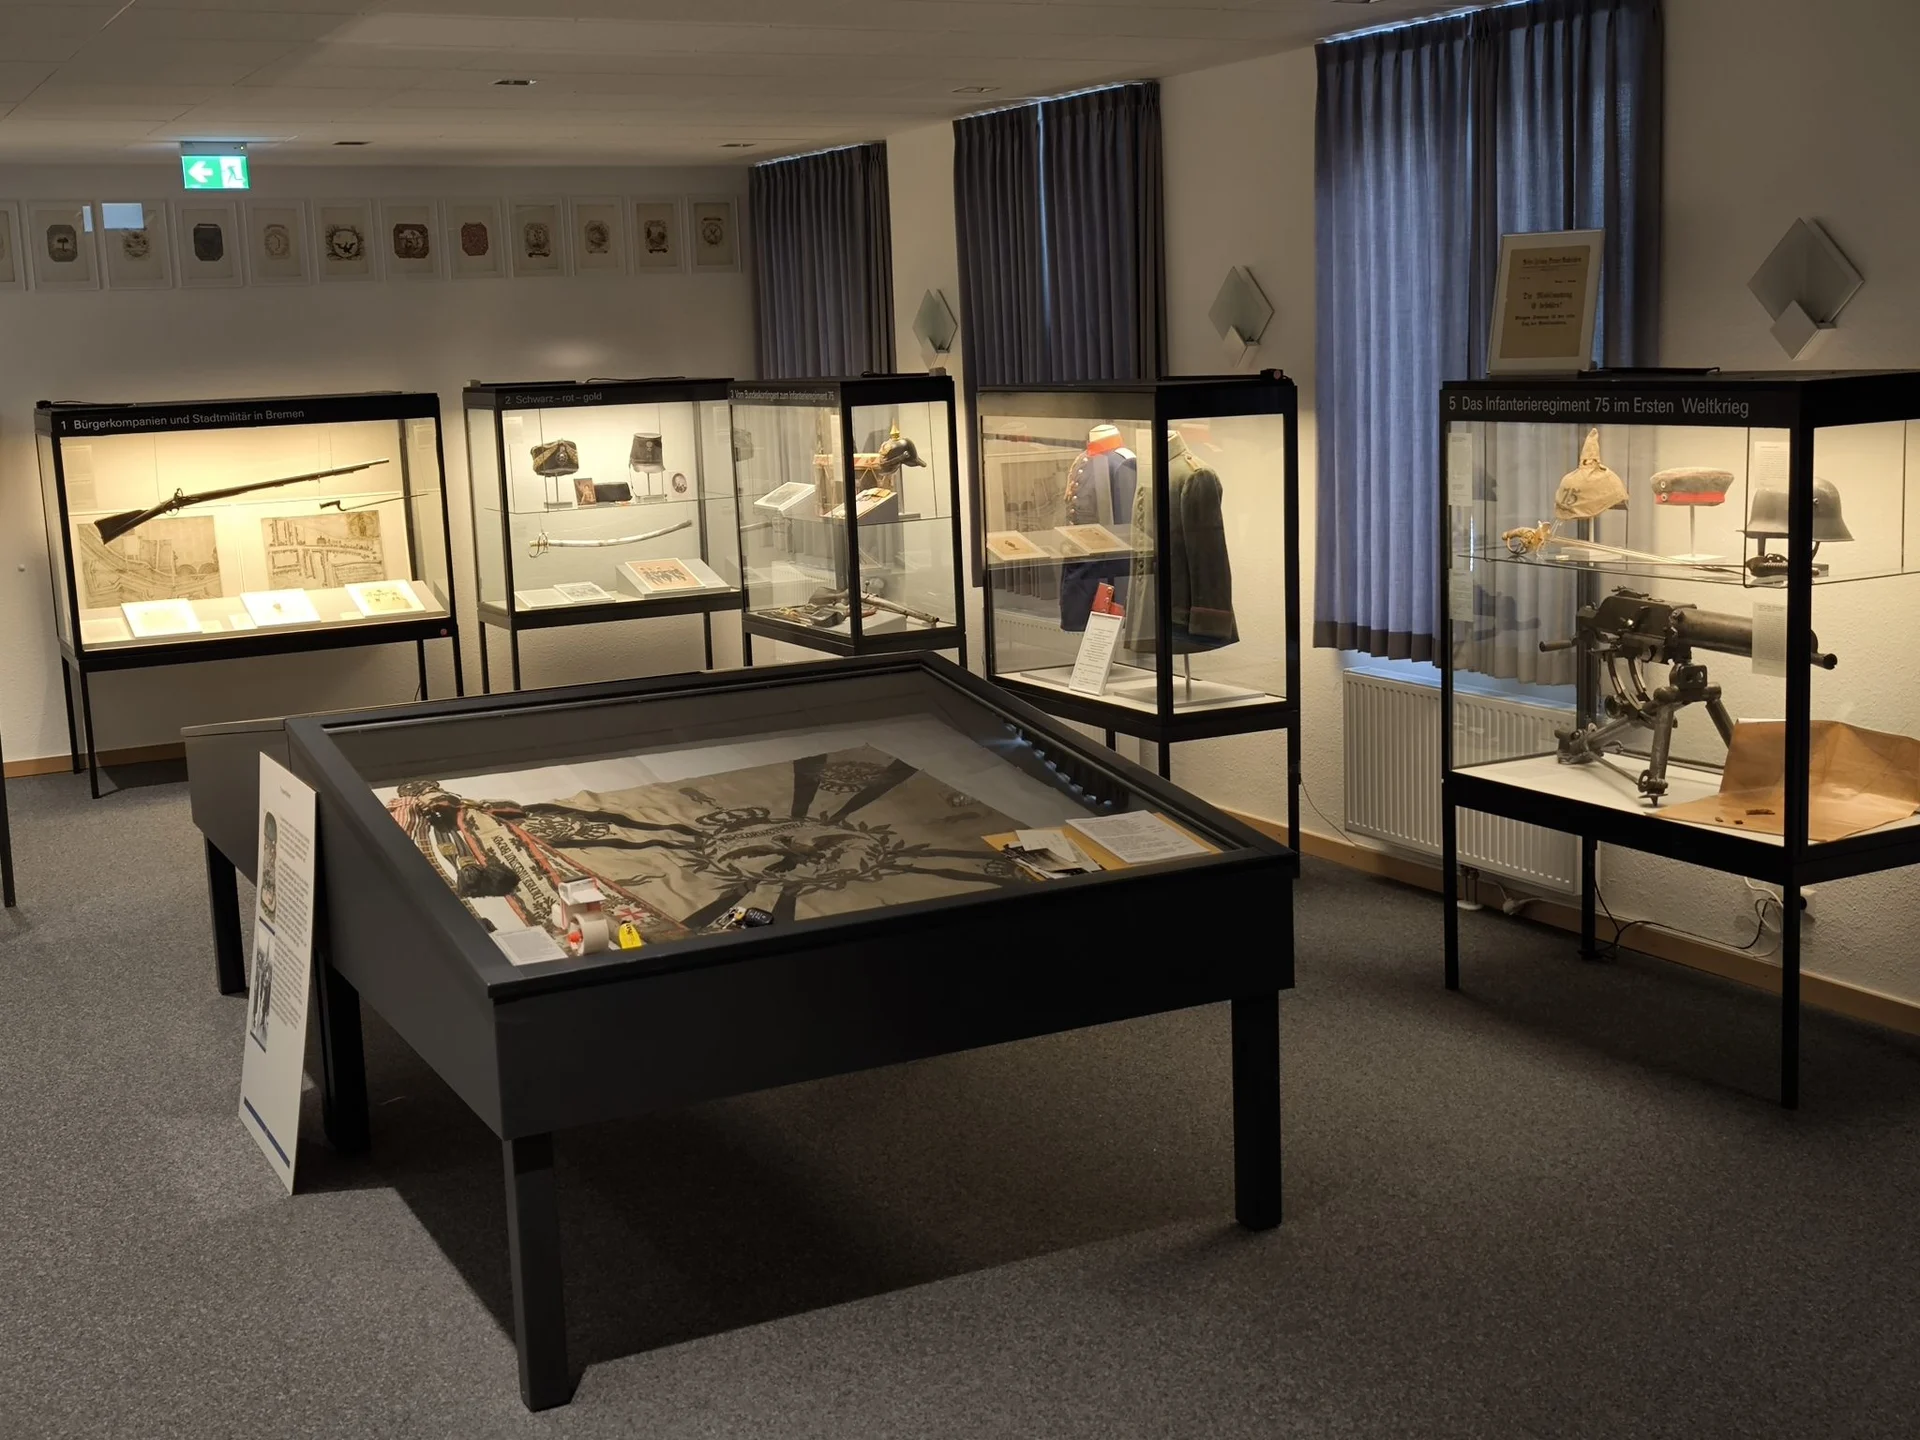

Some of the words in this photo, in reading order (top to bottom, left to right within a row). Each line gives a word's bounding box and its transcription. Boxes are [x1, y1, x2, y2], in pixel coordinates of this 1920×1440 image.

[505, 396, 511, 404] 2
[515, 394, 554, 404] Schwarz
[583, 392, 602, 403] gold
[1449, 396, 1456, 410] 5
[1462, 396, 1482, 410] Das
[1486, 396, 1590, 415] Infanterieregiment
[1594, 397, 1610, 412] 75
[1614, 397, 1629, 412] im
[1634, 397, 1674, 413] Ersten
[1682, 397, 1749, 418] Weltkrieg
[61, 421, 66, 430] 1
[73, 418, 167, 431] Bürgerkompanien
[170, 415, 189, 424] und
[192, 412, 251, 424] Stadtmilitär
[253, 411, 263, 420] in
[265, 410, 305, 421] Bremen
[1561, 488, 1581, 505] 75
